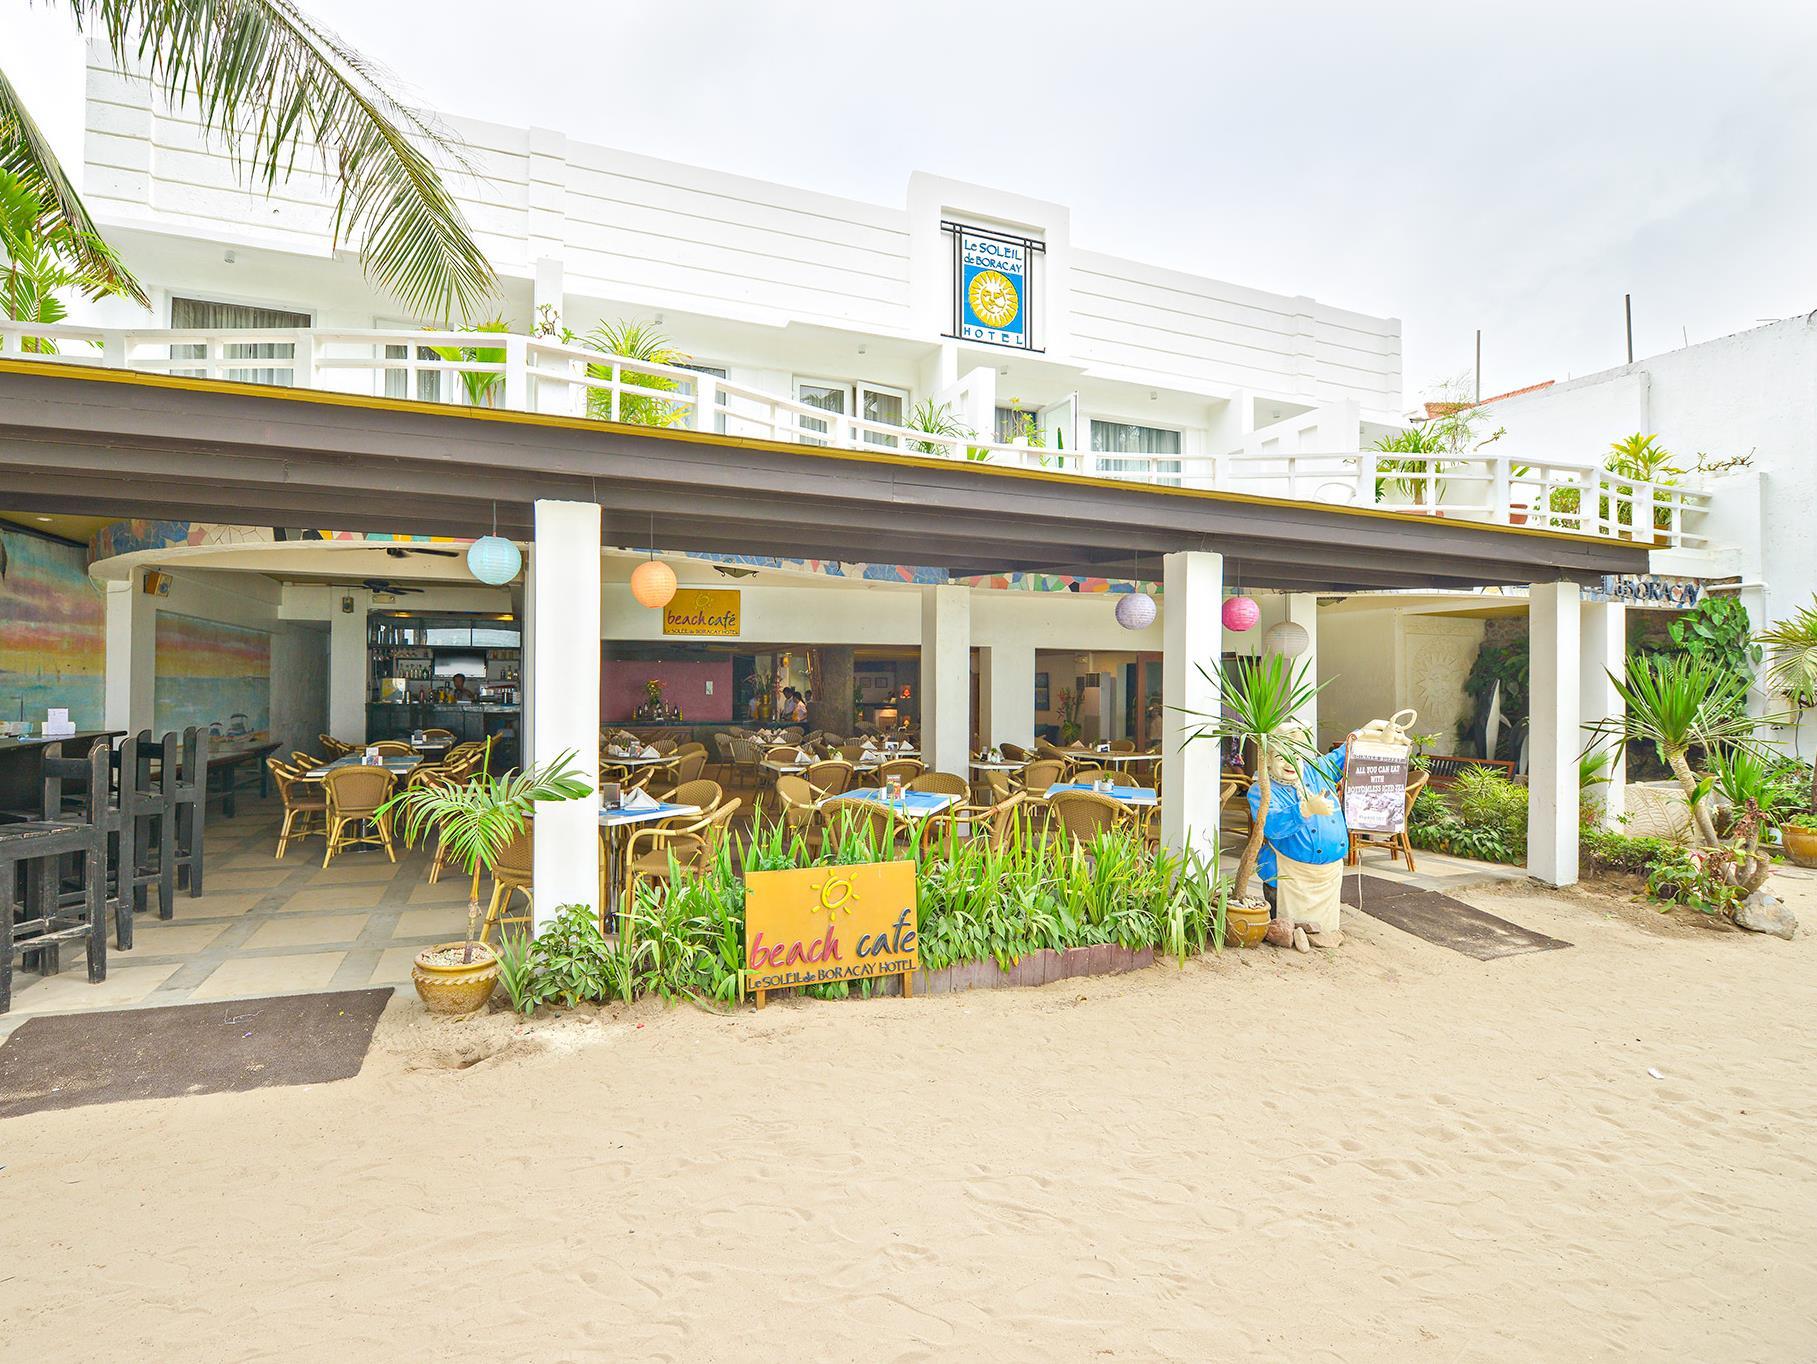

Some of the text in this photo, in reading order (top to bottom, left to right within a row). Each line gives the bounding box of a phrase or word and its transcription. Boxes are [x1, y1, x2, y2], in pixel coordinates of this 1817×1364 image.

[964, 239, 1023, 261] Le SOLEIL
[964, 252, 1023, 273] de BORACAY
[964, 327, 1023, 345] HOTEL
[667, 609, 736, 629] beach café
[1367, 765, 1377, 775] YOU
[1378, 765, 1390, 773] CAN
[1391, 765, 1400, 773] EAT
[1370, 775, 1385, 783] WITH
[1347, 783, 1405, 795] BOTTOMLESS ICED TEA
[750, 907, 917, 971] beach cafe
[748, 958, 917, 990] Le SOLEIL de BORACAY HOTEL
